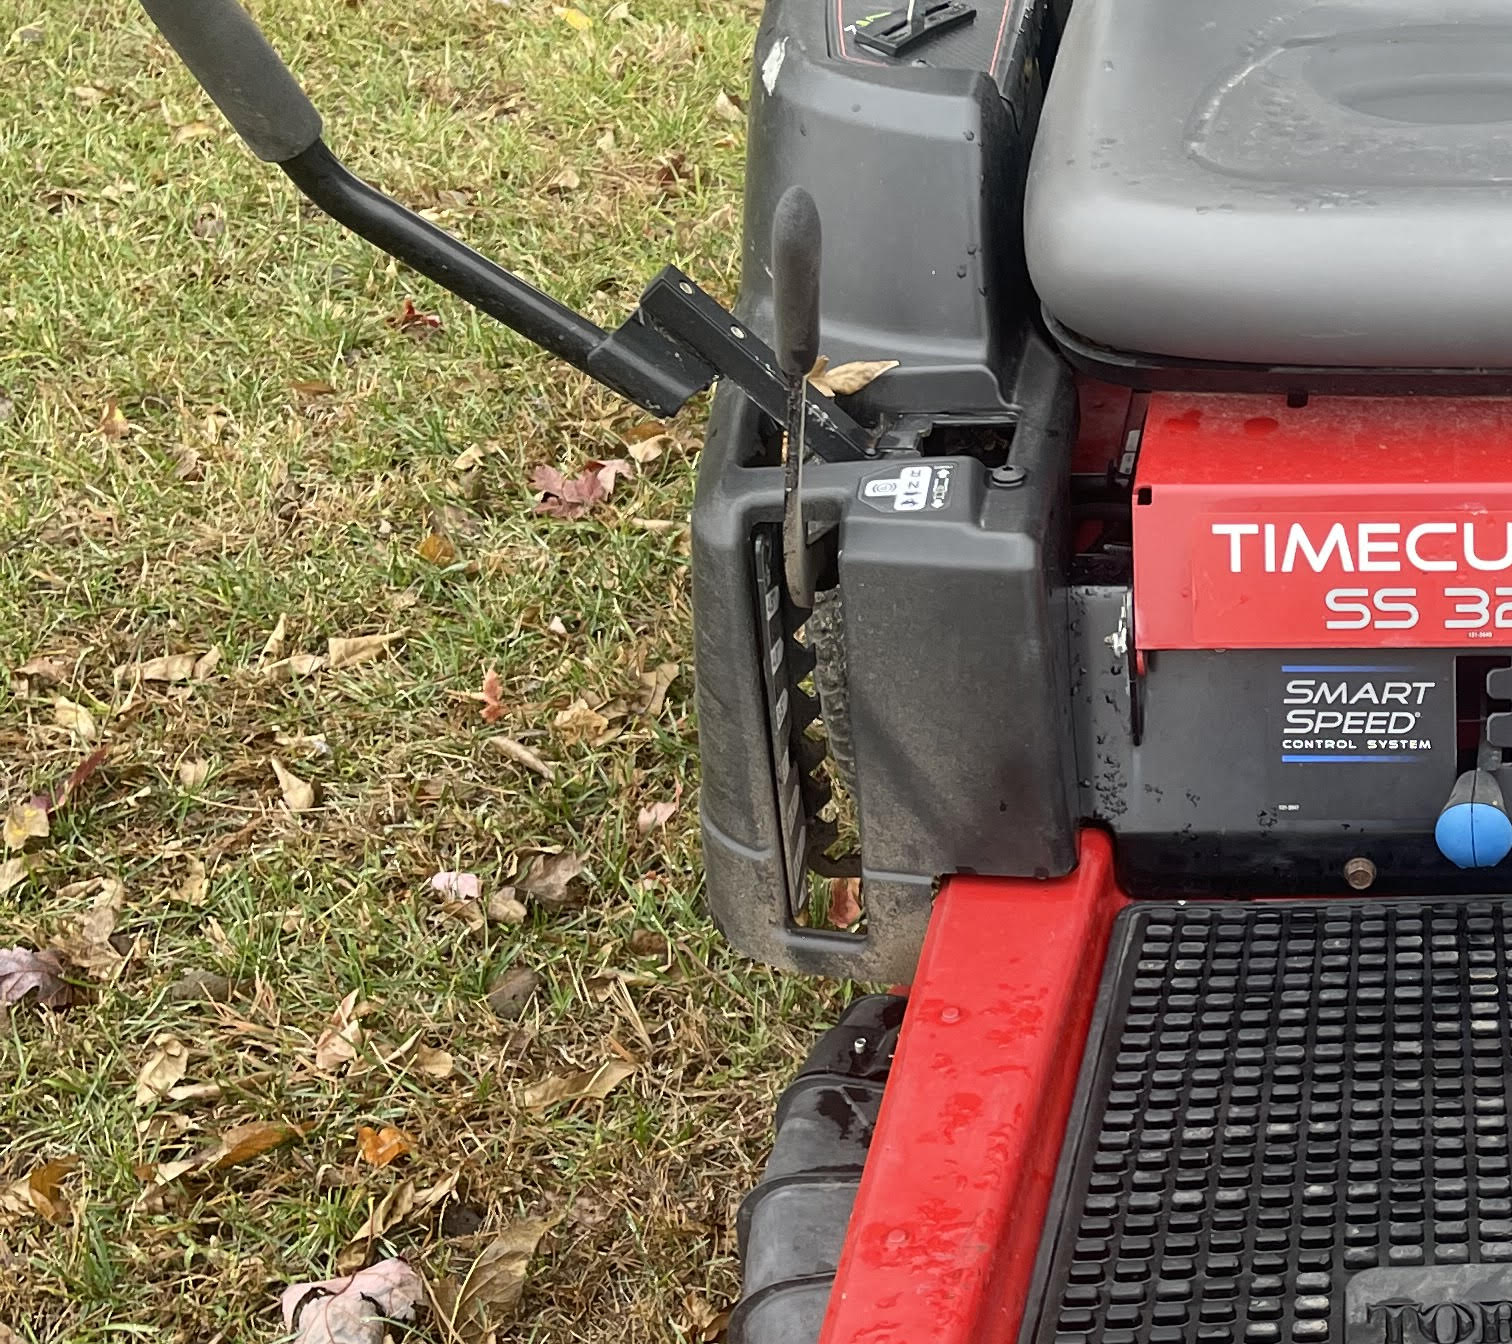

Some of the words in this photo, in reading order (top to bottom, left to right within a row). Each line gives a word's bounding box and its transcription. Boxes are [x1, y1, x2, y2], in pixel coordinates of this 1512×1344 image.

[1325, 588, 1419, 630] SS
[1283, 679, 1436, 705] SMART
[1283, 709, 1417, 734] SPEED
[1282, 739, 1357, 749] CONTROL
[1367, 739, 1432, 749] SYSTEM
